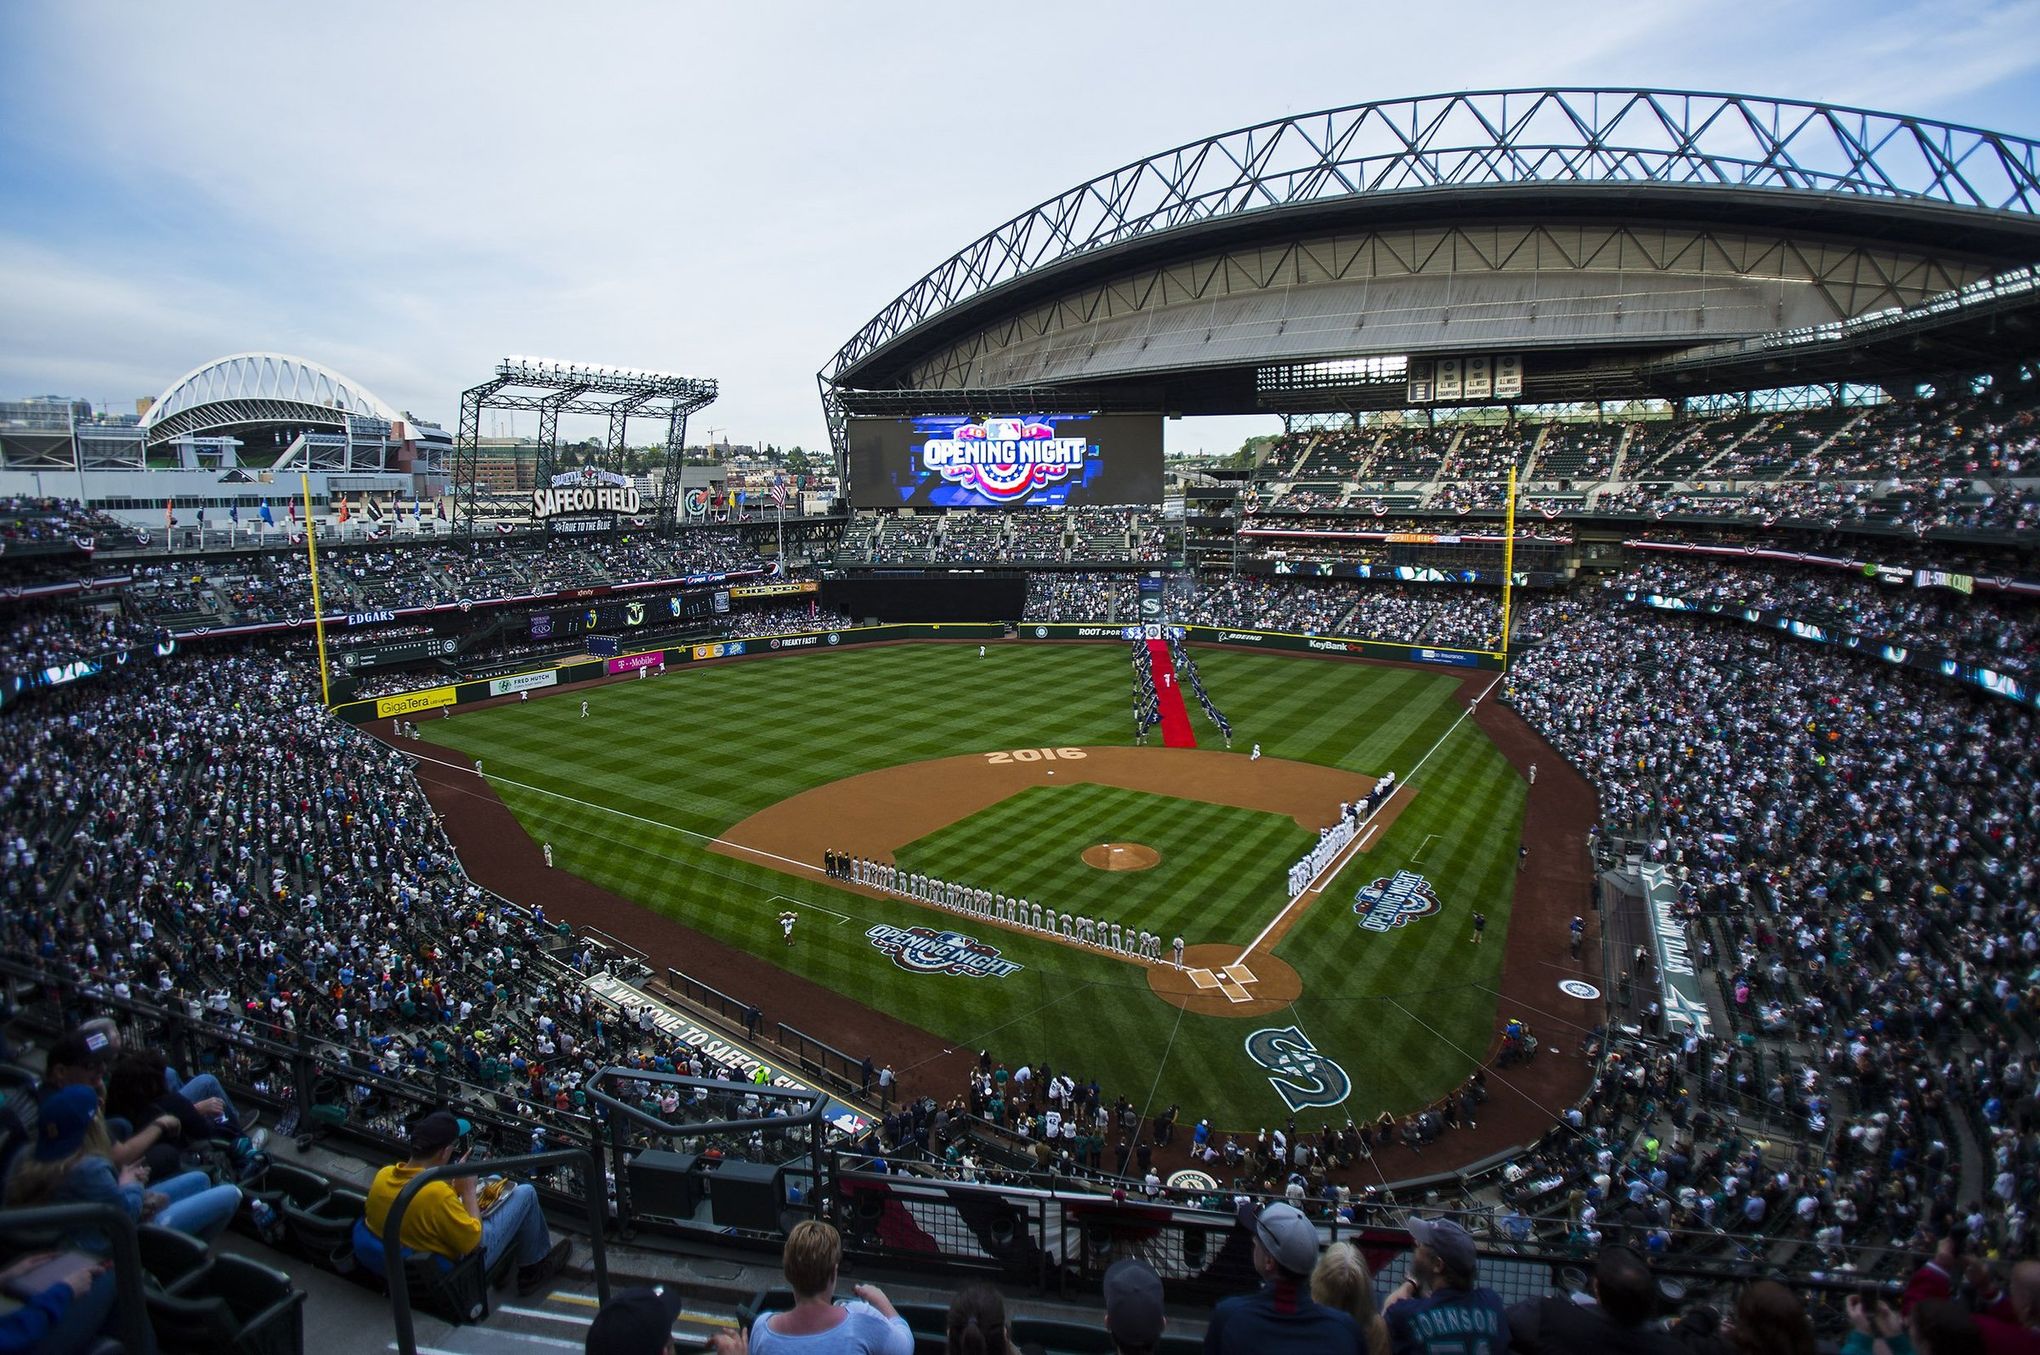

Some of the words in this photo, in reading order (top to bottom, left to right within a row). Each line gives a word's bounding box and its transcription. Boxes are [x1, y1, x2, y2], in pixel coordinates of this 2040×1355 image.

[1438, 389, 1461, 397] CHAMPIONS
[927, 439, 1017, 465] OPENING
[1018, 439, 1086, 465] NIGHT
[533, 487, 595, 518] SAFECO
[597, 487, 640, 515] FIELD
[562, 522, 577, 532] TRUE
[577, 522, 585, 531] TO
[585, 521, 597, 531] THE
[597, 520, 611, 531] BLUE
[736, 586, 766, 595] THE
[1953, 574, 1973, 595] CLUB
[577, 589, 594, 597] xfinity
[348, 610, 395, 625] EDGARS
[1078, 628, 1102, 636] ROOT
[1229, 633, 1263, 641] BOEING
[782, 639, 802, 647] FREAKY
[802, 637, 817, 645] FAST!
[1309, 640, 1348, 651] KeyBank
[513, 677, 530, 685] FRED
[530, 673, 550, 682] HUTCH
[381, 696, 430, 714] GigaTera
[984, 747, 1088, 764] 2016
[1387, 870, 1421, 896] NIGHT
[1361, 892, 1406, 931] OPENING
[868, 925, 956, 957] OPENING
[949, 948, 1021, 975] NIGHT
[677, 1025, 711, 1048] TO
[1407, 1306, 1499, 1342] JOHNSON
